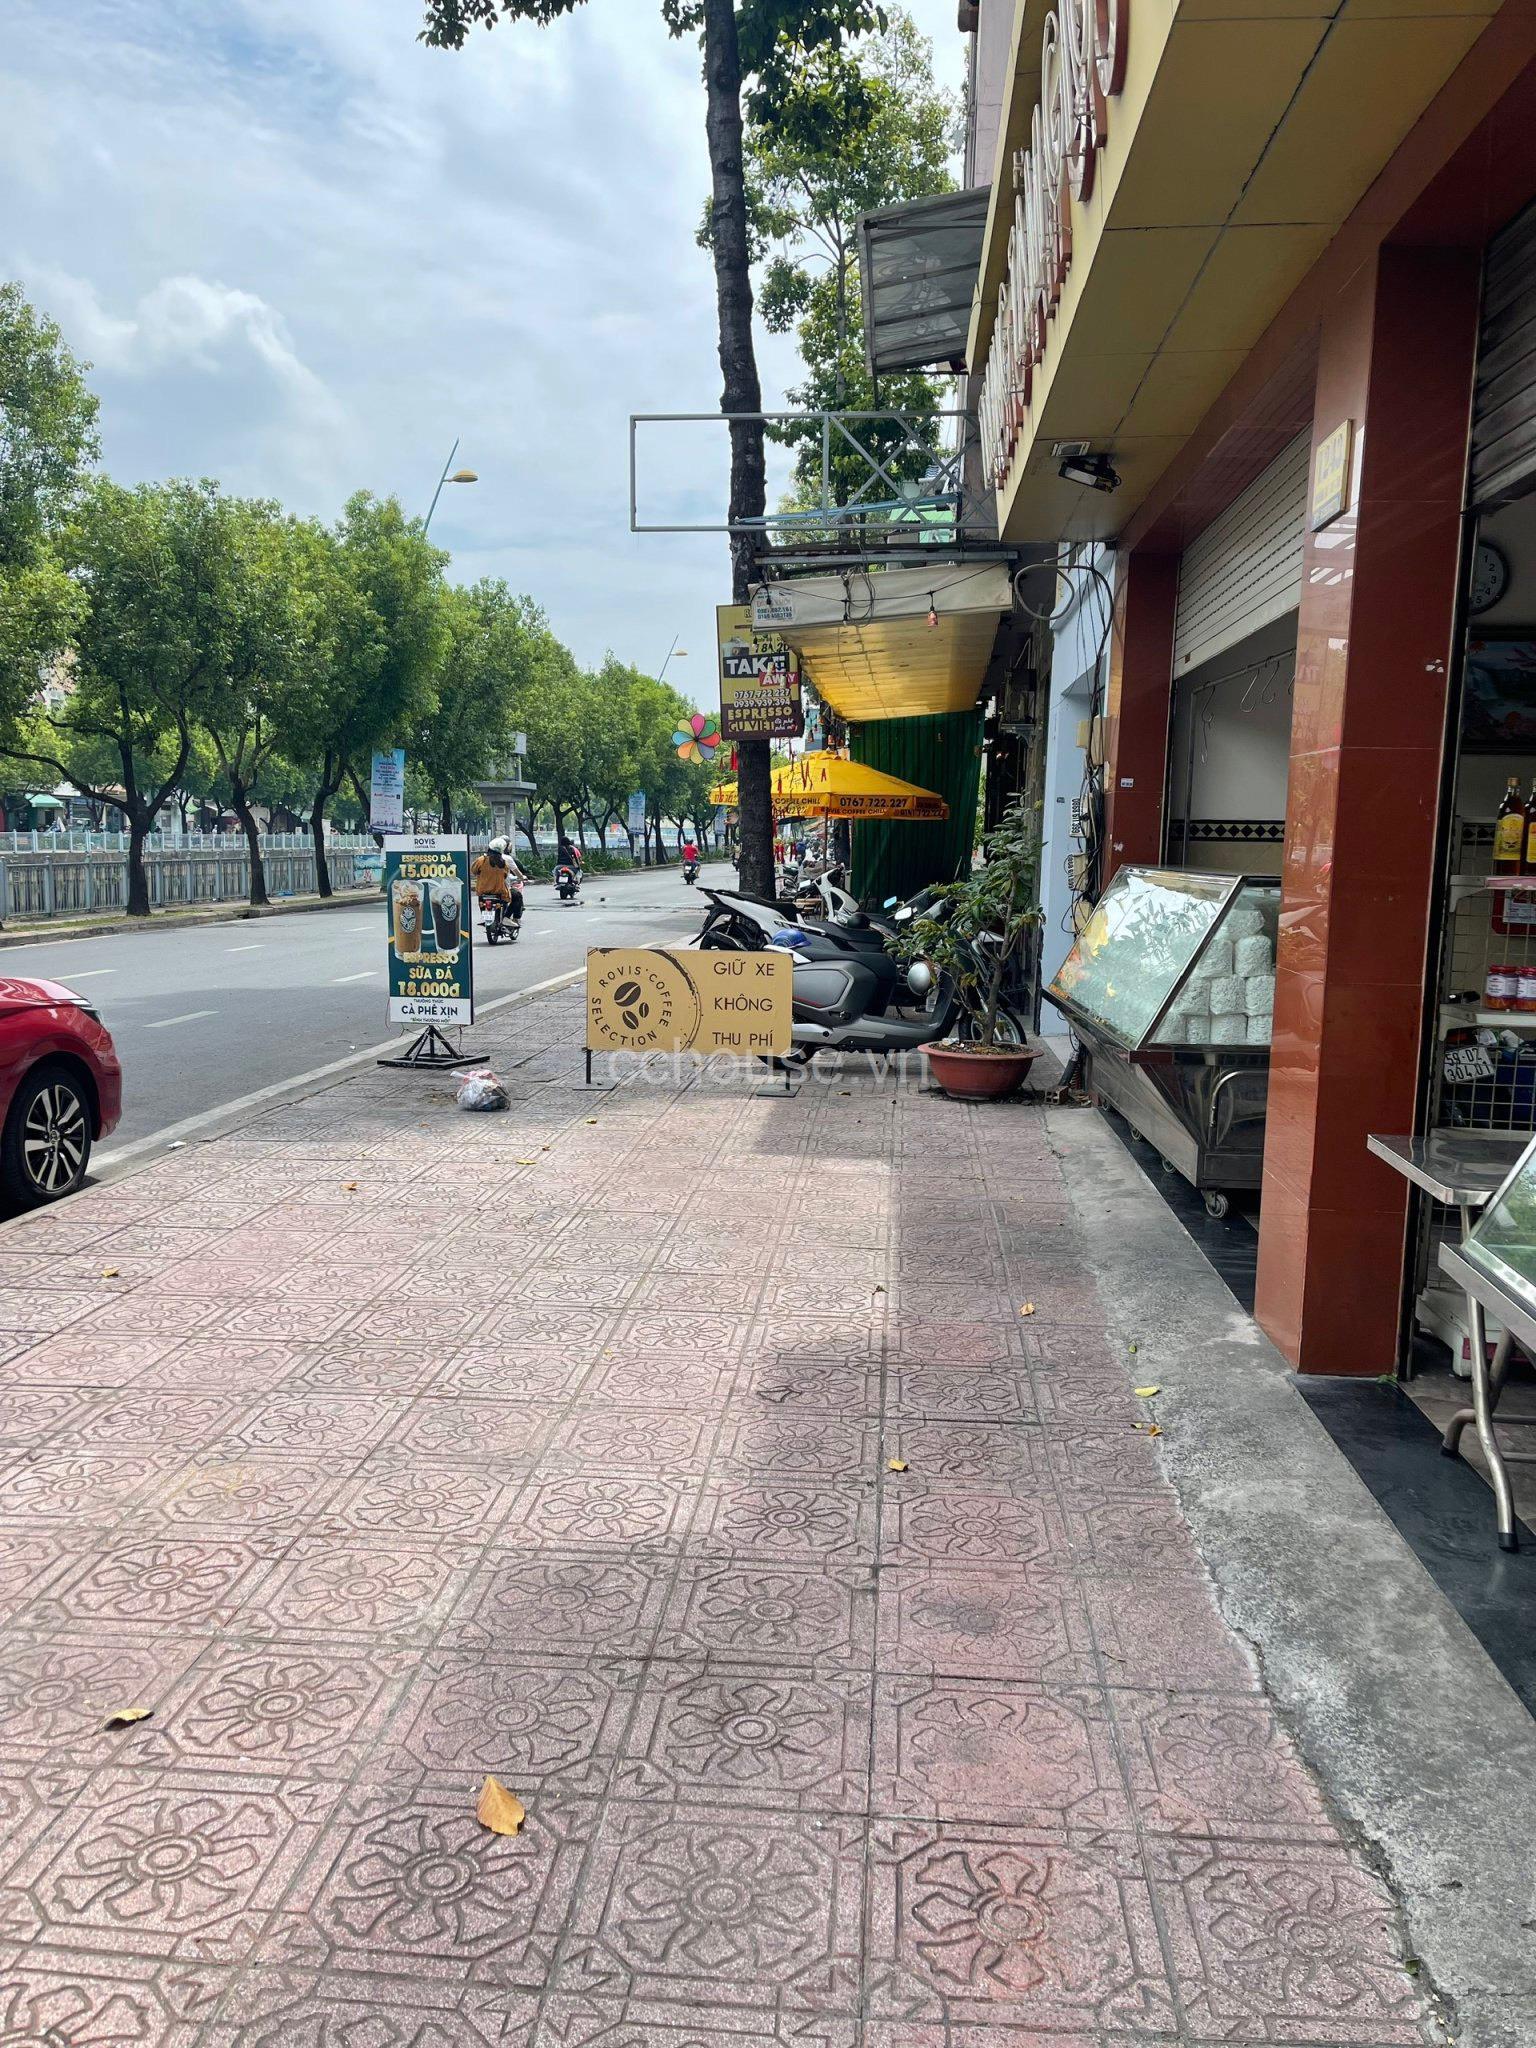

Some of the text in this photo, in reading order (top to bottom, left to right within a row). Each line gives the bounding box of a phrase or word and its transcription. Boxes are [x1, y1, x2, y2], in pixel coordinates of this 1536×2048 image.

[1488, 563, 1496, 572] 2
[1490, 575, 1497, 585] 3
[1484, 587, 1491, 596] 4
[726, 655, 787, 675] TAKE
[762, 673, 796, 685] AWY
[733, 698, 791, 708] 0939.939.394
[727, 706, 792, 721] ESPRESSO
[839, 797, 907, 808] 0767.722.227
[401, 852, 453, 862] ESPRESSO ĐÁ
[403, 951, 459, 964] ESPRESSO
[409, 965, 454, 980] SỮA ĐÁ
[713, 958, 775, 976] GIỮ XE
[598, 965, 673, 1028] ROVIS COFFEE
[714, 993, 773, 1011] KHÔNG
[401, 1003, 458, 1019] CÀ PHÊ XỊN
[591, 997, 658, 1046] SELECTION
[712, 1029, 773, 1046] THU PHÍ
